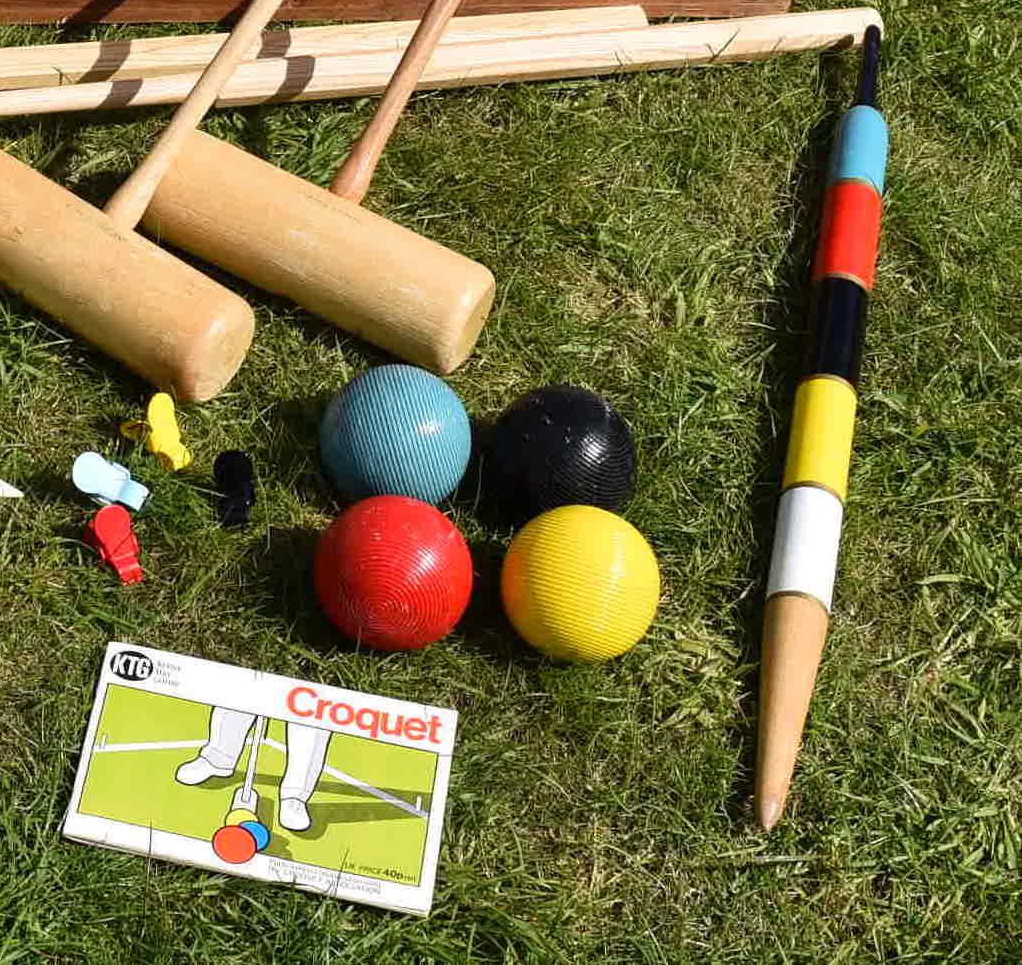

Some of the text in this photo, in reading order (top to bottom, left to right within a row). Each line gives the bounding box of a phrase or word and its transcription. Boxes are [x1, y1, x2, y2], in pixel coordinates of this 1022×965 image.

[112, 652, 152, 679] KTG
[285, 685, 443, 745] Croquet
[382, 868, 404, 881] 40p
